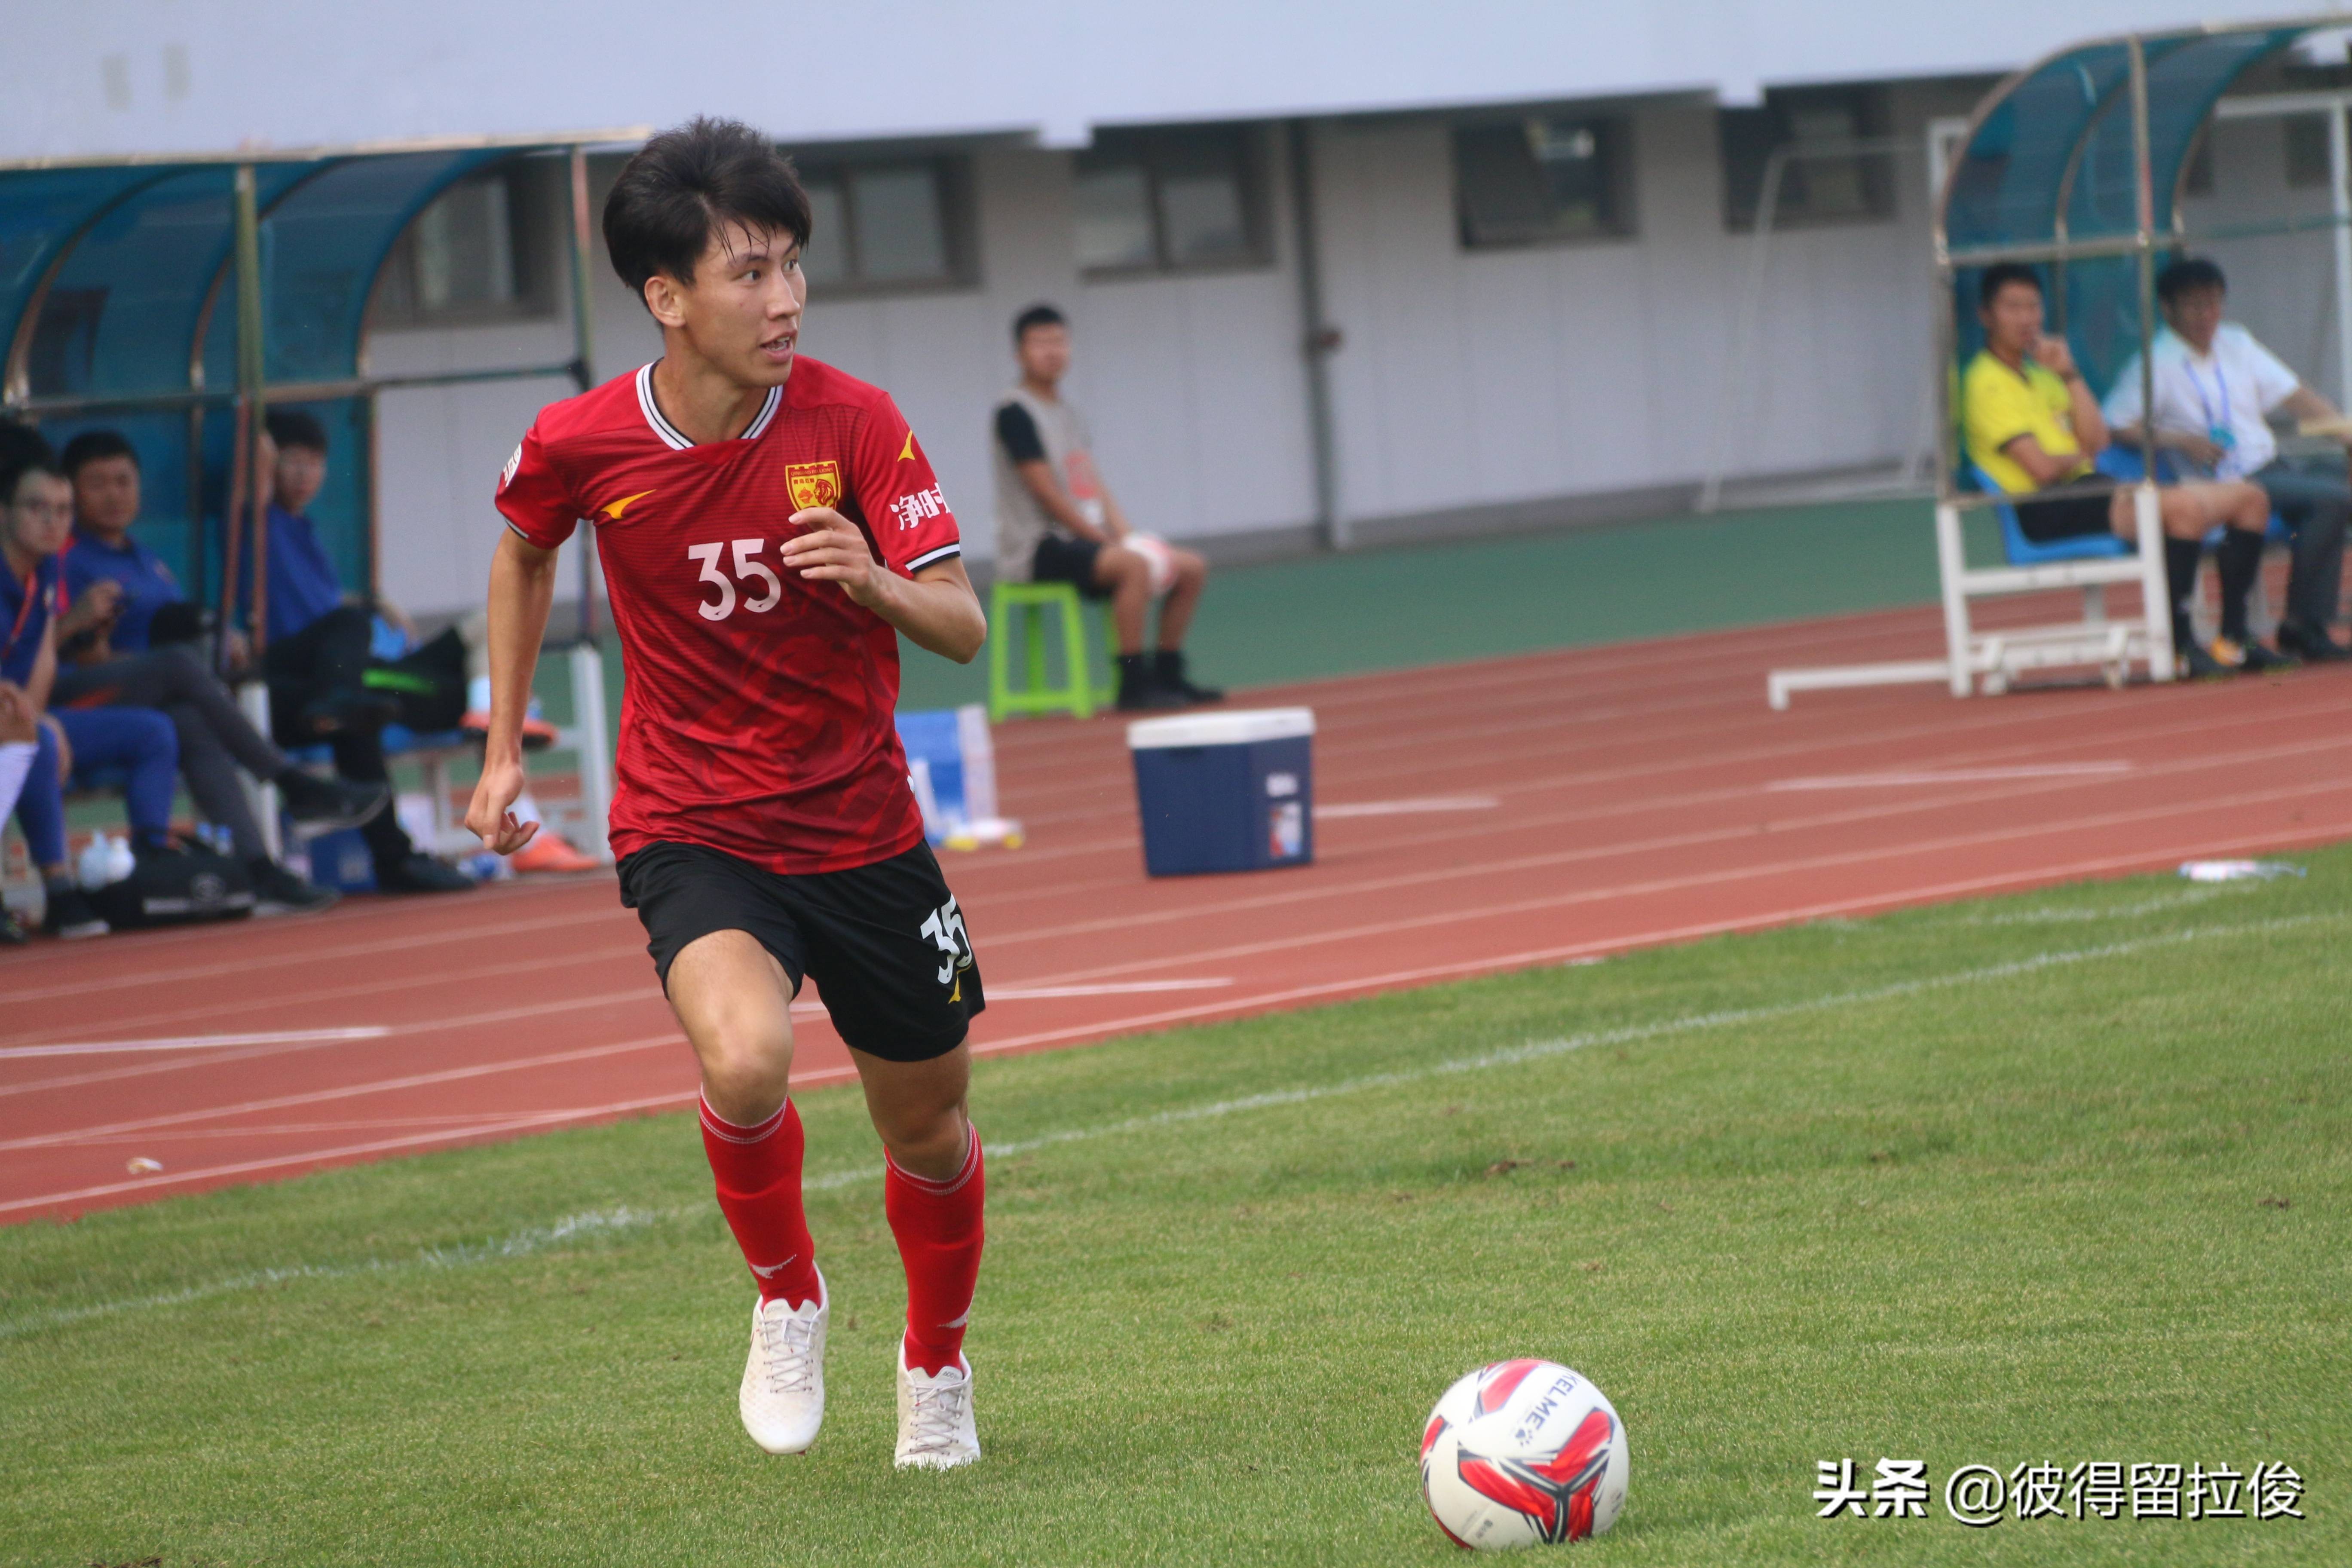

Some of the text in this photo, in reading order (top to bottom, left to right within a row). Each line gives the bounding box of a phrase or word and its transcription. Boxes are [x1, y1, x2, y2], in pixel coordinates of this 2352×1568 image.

[688, 538, 781, 621] 35
[920, 893, 972, 984] 35
[1526, 1372, 1581, 1430] KELME
